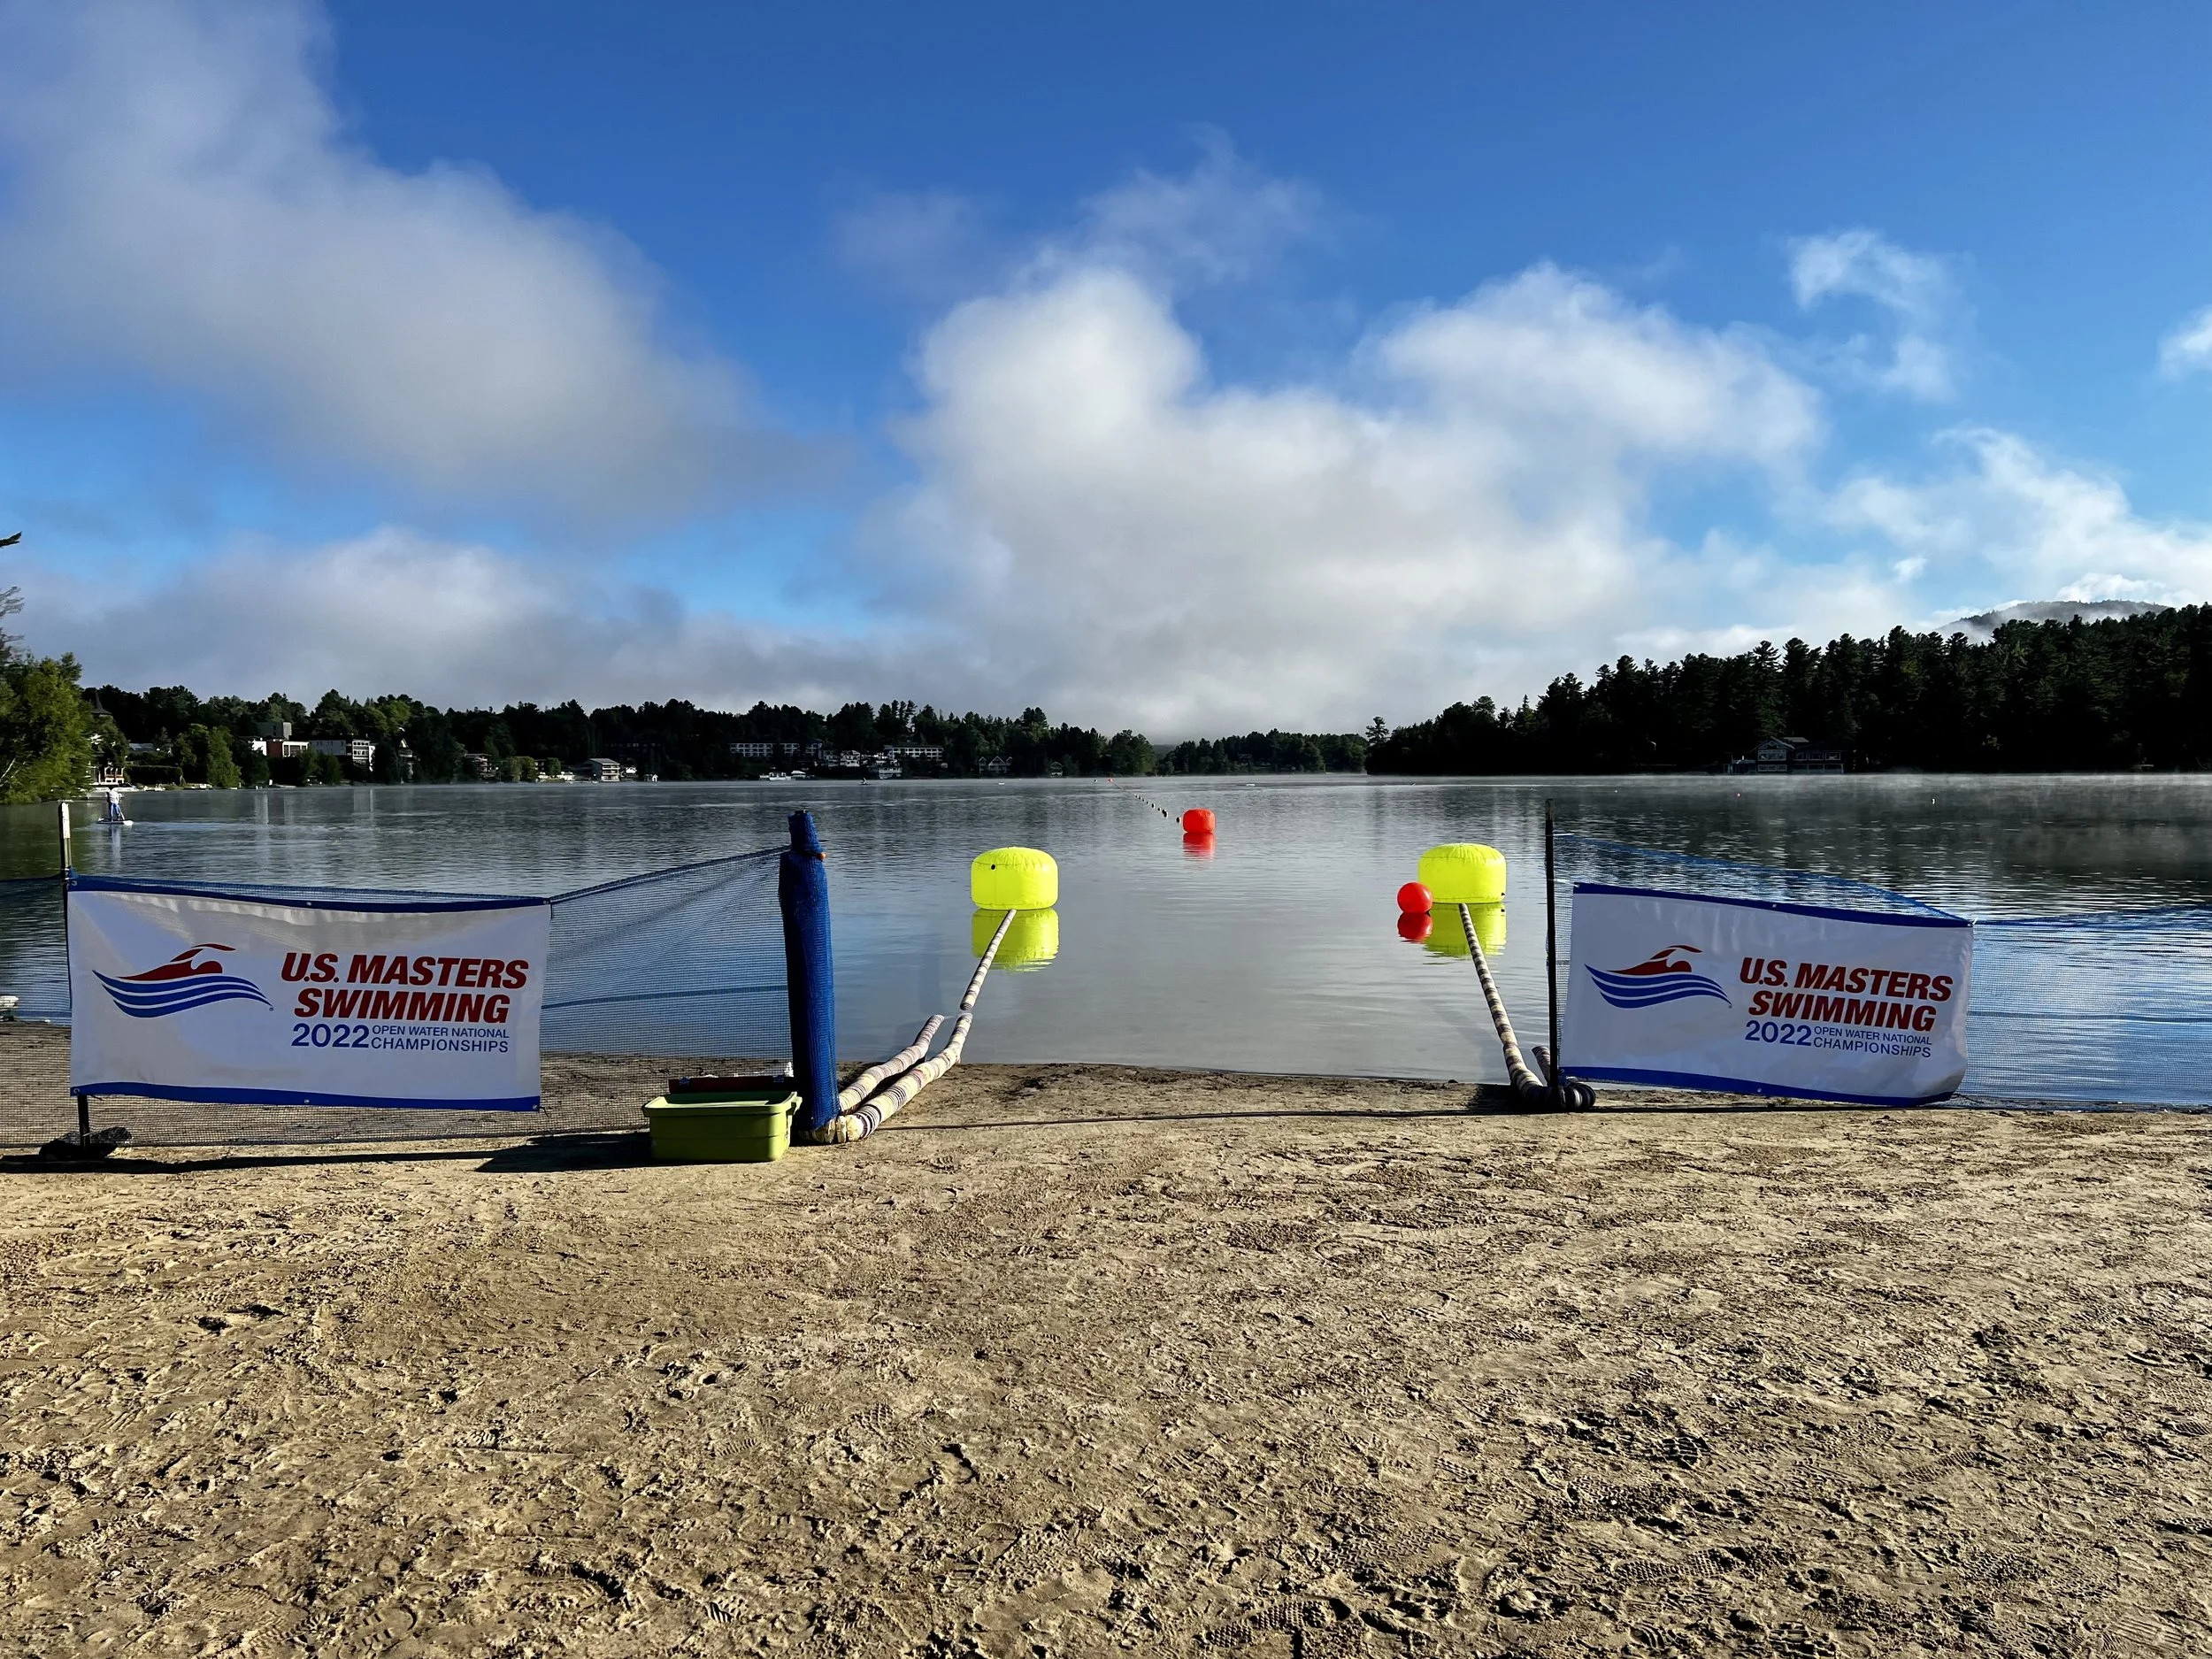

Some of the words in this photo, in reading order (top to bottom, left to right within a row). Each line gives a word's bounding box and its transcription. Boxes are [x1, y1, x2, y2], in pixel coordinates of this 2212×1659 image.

[280, 952, 340, 983] U.S.
[346, 954, 529, 989] MASTERS
[1740, 956, 1788, 987] U.S.
[1793, 963, 1954, 1002] MASTERS
[294, 987, 511, 1024] SWIMMING
[1748, 990, 1937, 1033] SWIMMING
[290, 1022, 370, 1048] 2022
[372, 1025, 405, 1035] OPEN
[406, 1025, 449, 1037] WATER
[451, 1027, 510, 1039] NATIONAL
[371, 1036, 509, 1053] CHAMPIONSHIPS
[1745, 1019, 1812, 1047] 2022
[1814, 1025, 1843, 1037] OPEN
[1845, 1029, 1880, 1041] WATER
[1883, 1032, 1932, 1046] NATIONAL
[1813, 1036, 1932, 1058] CHAMPIONSHIPS
